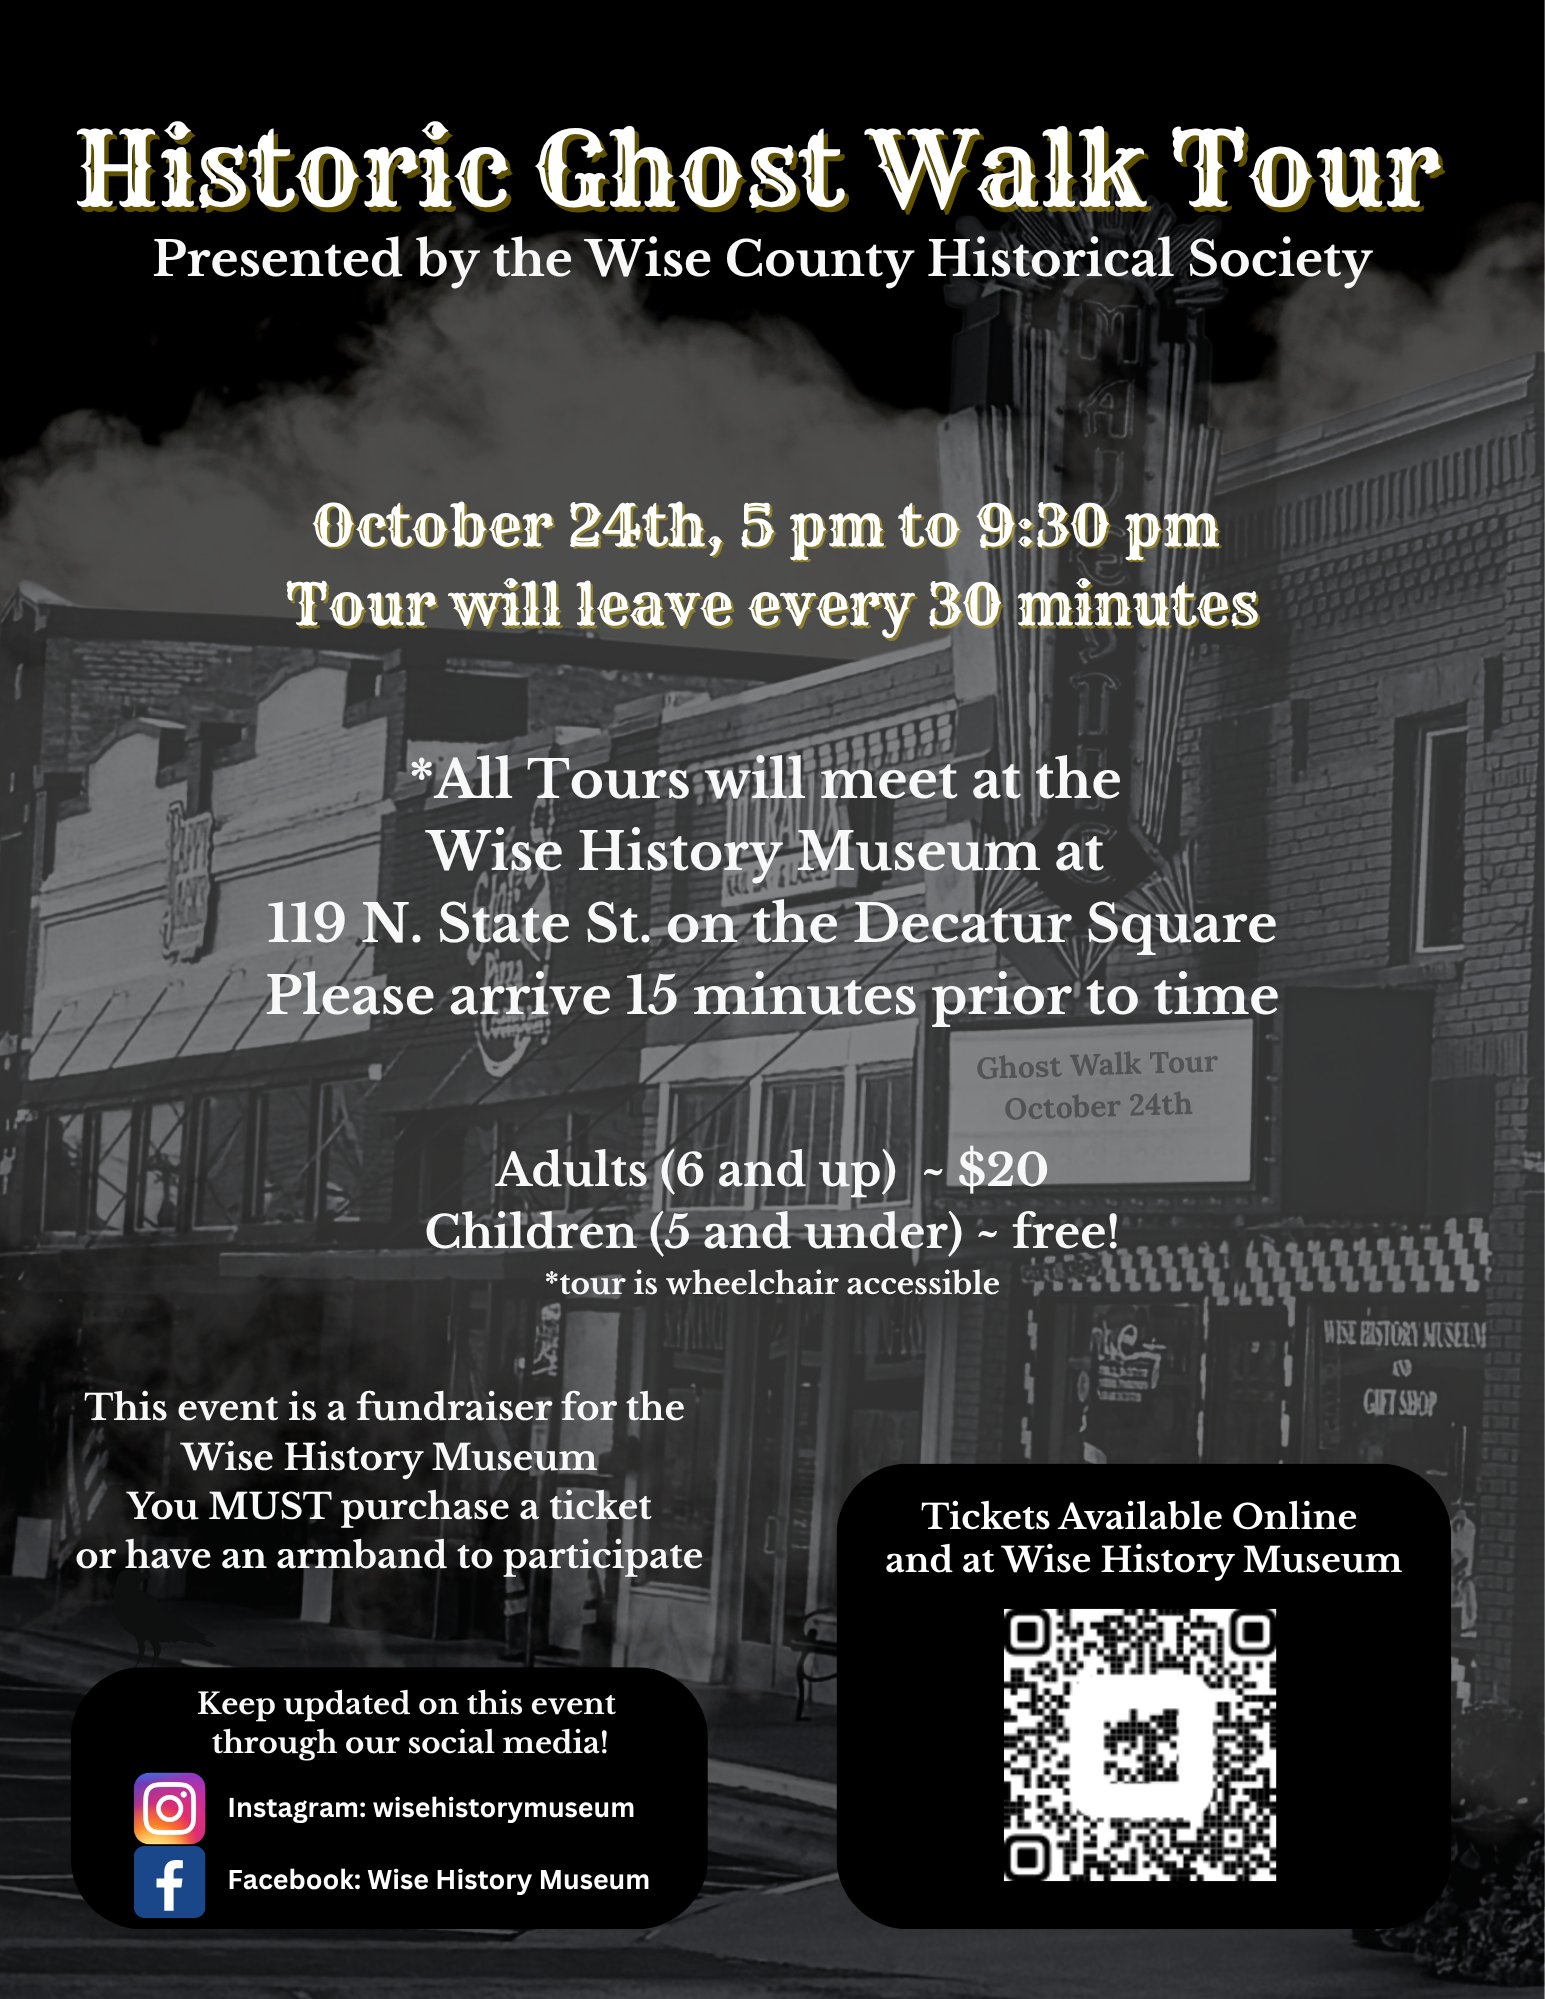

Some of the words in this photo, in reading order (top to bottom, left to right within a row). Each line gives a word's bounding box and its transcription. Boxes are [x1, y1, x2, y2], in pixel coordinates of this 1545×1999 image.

[976, 1055, 1063, 1080] Ghost
[1070, 1051, 1142, 1077] Walk
[1149, 1051, 1218, 1074] Tour
[1004, 1095, 1121, 1120] October
[1129, 1091, 1193, 1117] 24th
[1323, 1319, 1358, 1345] WISE
[1359, 1319, 1419, 1347] HISTORY
[1422, 1320, 1487, 1349] MUSEUM
[1362, 1388, 1397, 1416] GIFT
[1398, 1389, 1438, 1417] SHOP
